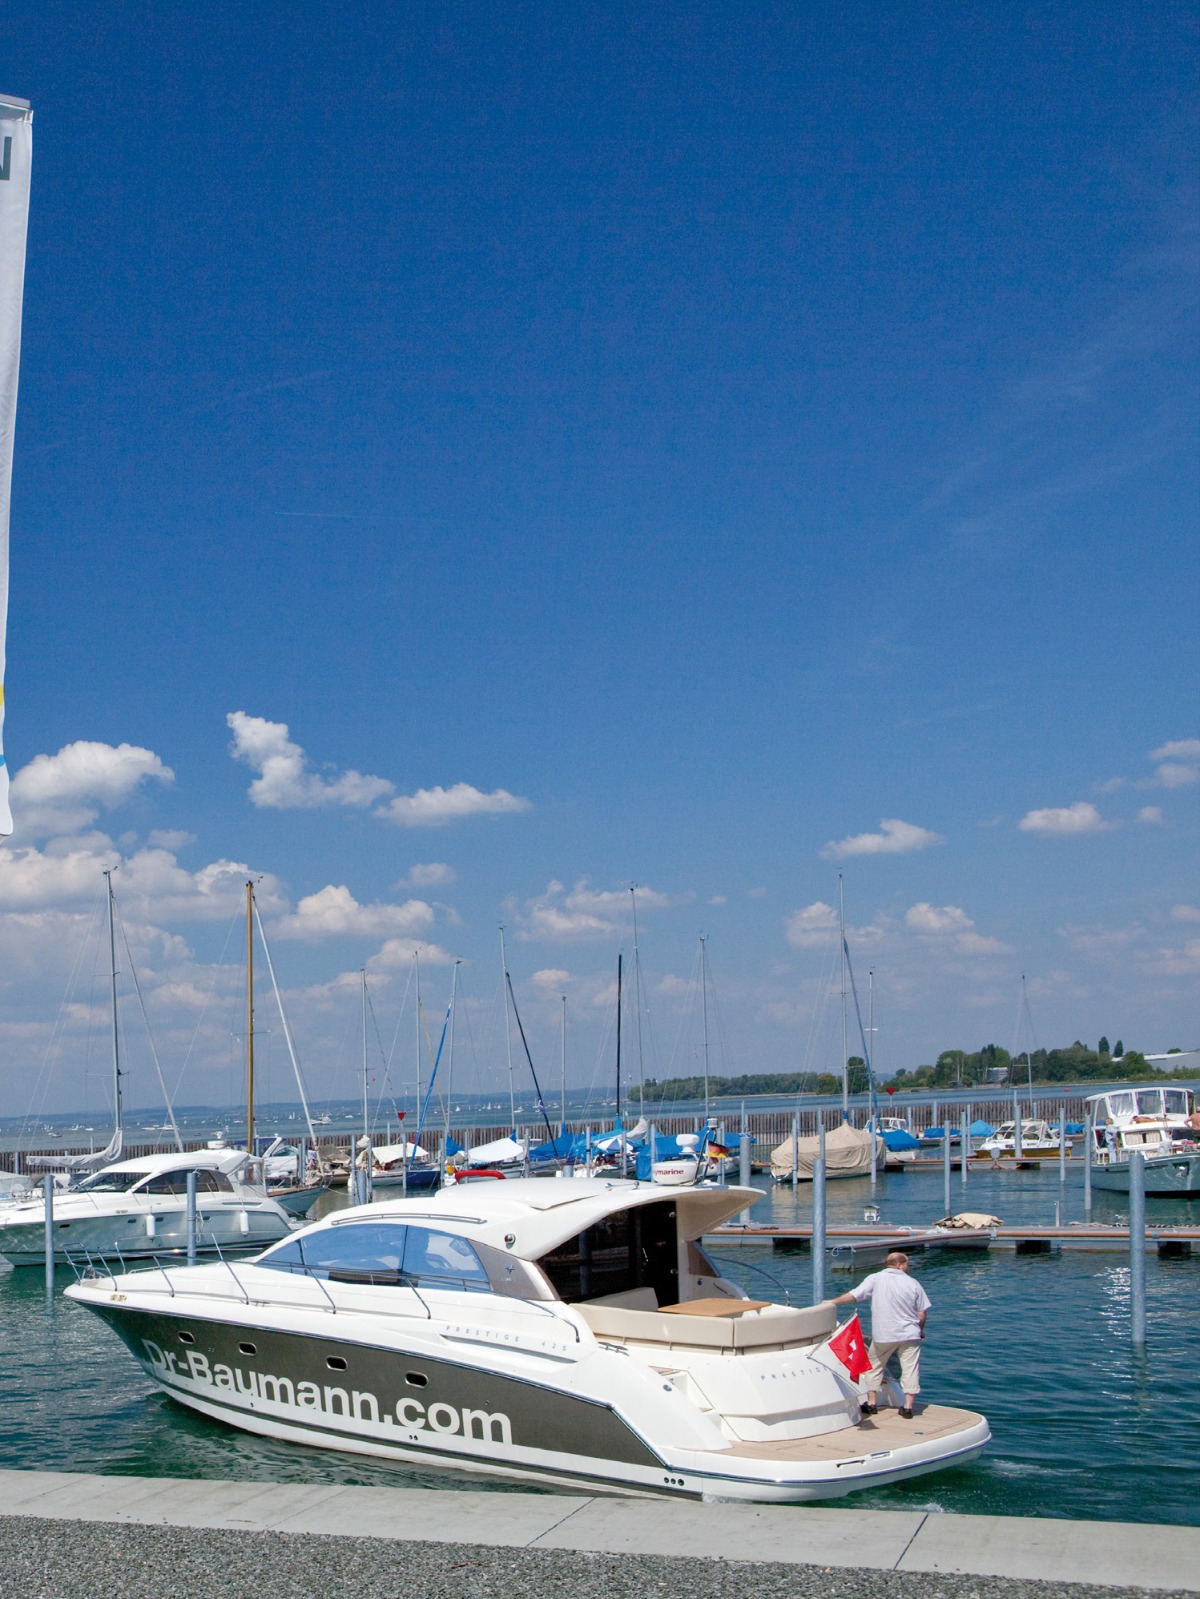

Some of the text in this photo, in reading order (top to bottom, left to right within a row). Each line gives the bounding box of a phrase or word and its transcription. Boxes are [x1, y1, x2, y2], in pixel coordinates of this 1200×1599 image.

[446, 1325, 567, 1352] PRESTIGE 425
[141, 1338, 513, 1446] Dr-Baumann.com
